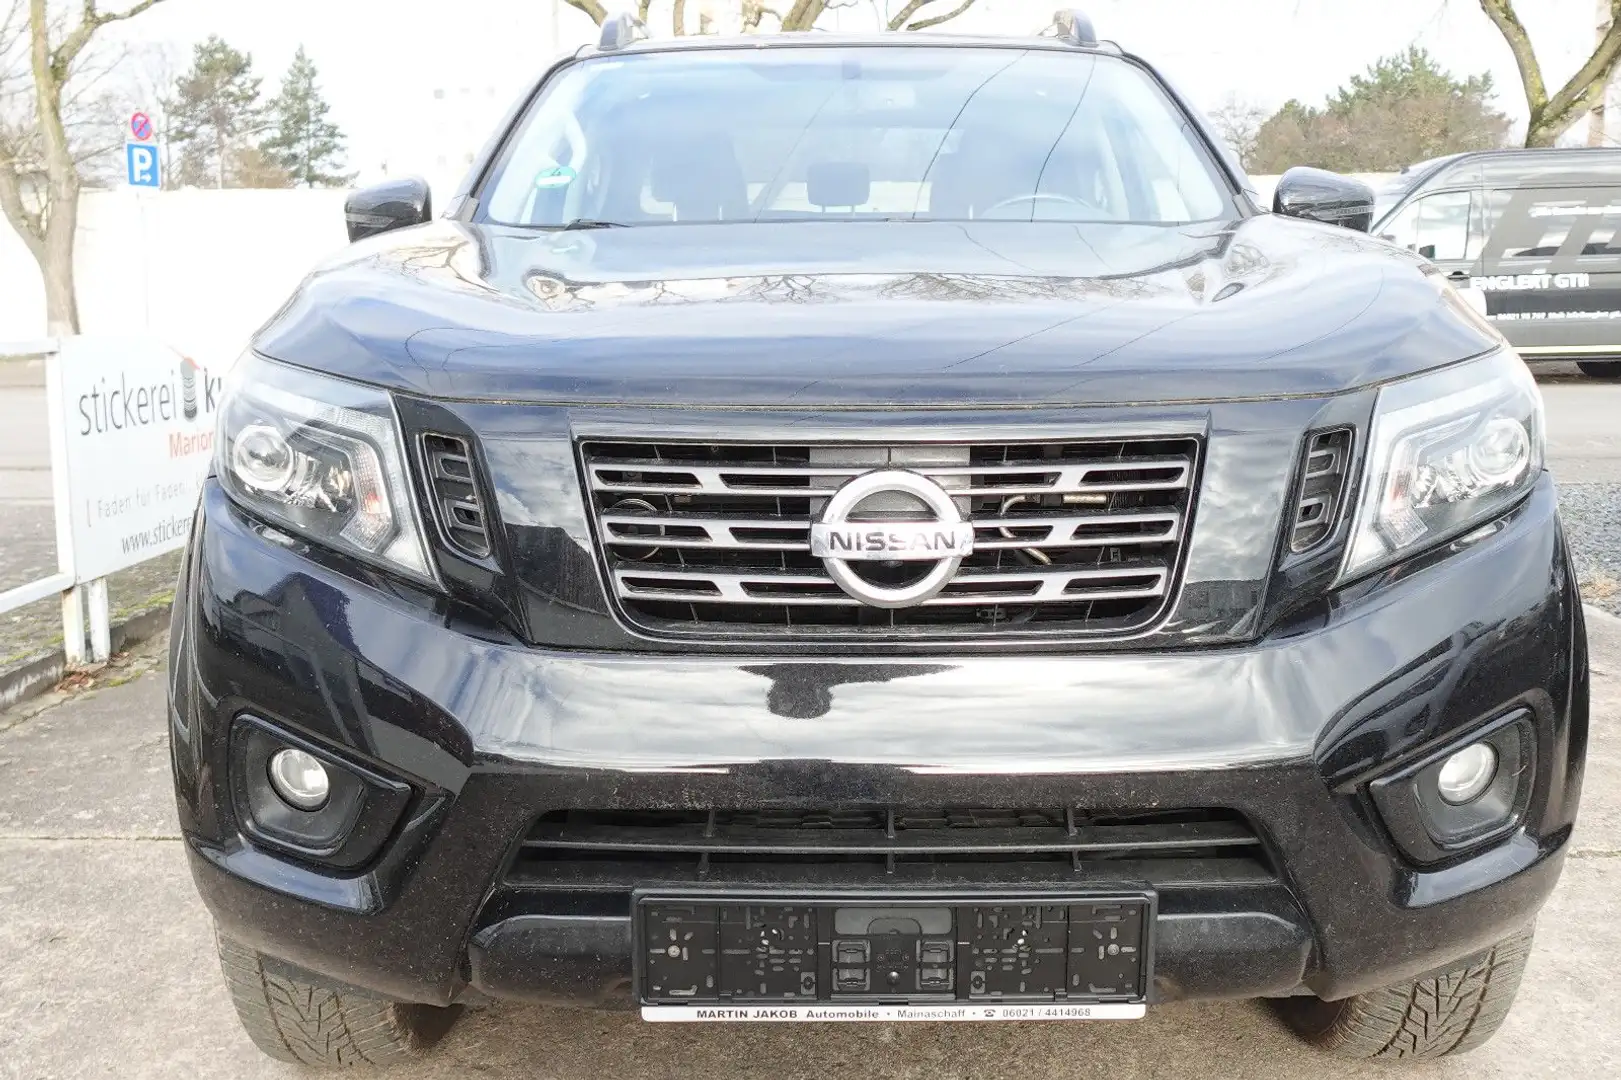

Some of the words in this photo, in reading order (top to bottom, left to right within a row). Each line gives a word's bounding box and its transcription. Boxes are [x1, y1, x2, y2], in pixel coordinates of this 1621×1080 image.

[133, 148, 152, 182] P
[1470, 275, 1552, 290] ENGLERT
[79, 370, 177, 436] stickerei
[97, 494, 132, 519] Faden
[829, 530, 955, 551] NISSAN
[696, 1010, 748, 1019] MARTIN
[753, 1010, 798, 1019] JAKOB
[806, 1009, 879, 1019] Automobile
[897, 1008, 966, 1019] Mainaschaff
[1002, 1007, 1034, 1018] 06021
[1045, 1007, 1091, 1018] 4414968
